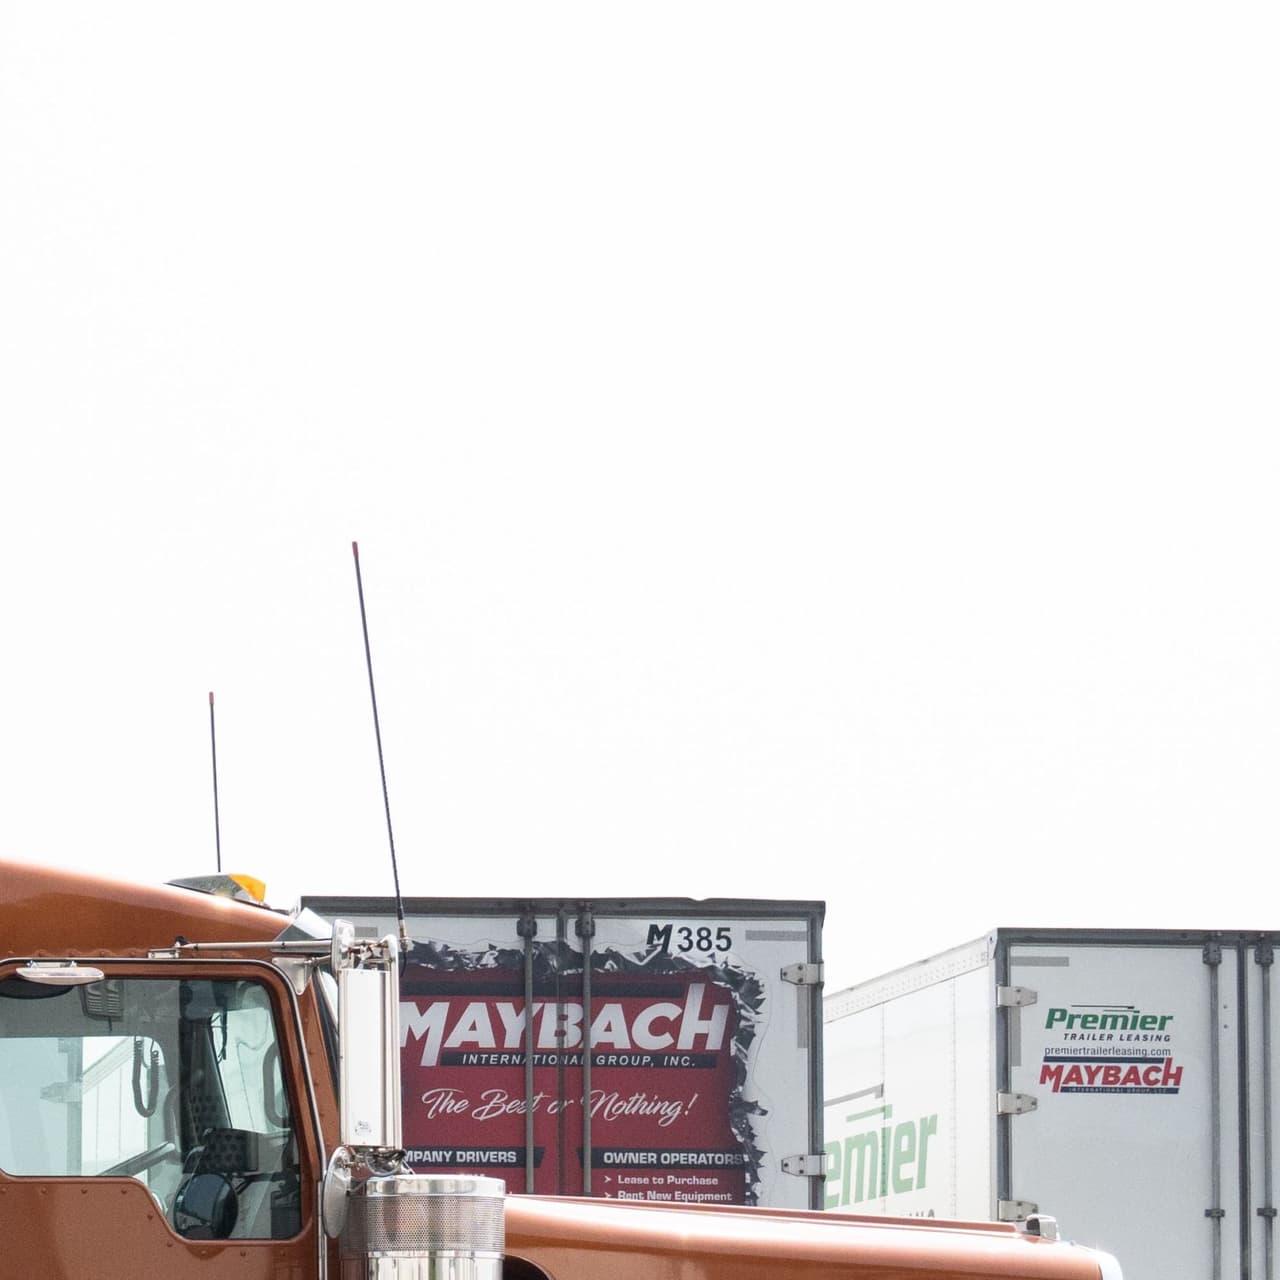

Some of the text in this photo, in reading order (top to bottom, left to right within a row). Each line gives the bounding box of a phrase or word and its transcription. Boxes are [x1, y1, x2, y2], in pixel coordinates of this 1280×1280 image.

[399, 983, 730, 1067] MAYBACH
[1045, 1008, 1173, 1031] Premier
[1064, 1033, 1171, 1042] TRAILER LEASING
[1044, 1046, 1171, 1057] premiertrailerleasing.com
[596, 1055, 655, 1067] GROUP,
[663, 1056, 696, 1067] INC.
[1039, 1058, 1183, 1092] MAYBACH
[421, 1088, 699, 1127] The Best or Nothing!
[404, 1150, 517, 1163] MPANY DRIVERS
[603, 1151, 744, 1165] OWNER OPERATORS
[824, 1113, 938, 1210] emier
[617, 1174, 719, 1186] Lease to Purchase
[617, 1190, 733, 1203] Rent New Equipment
